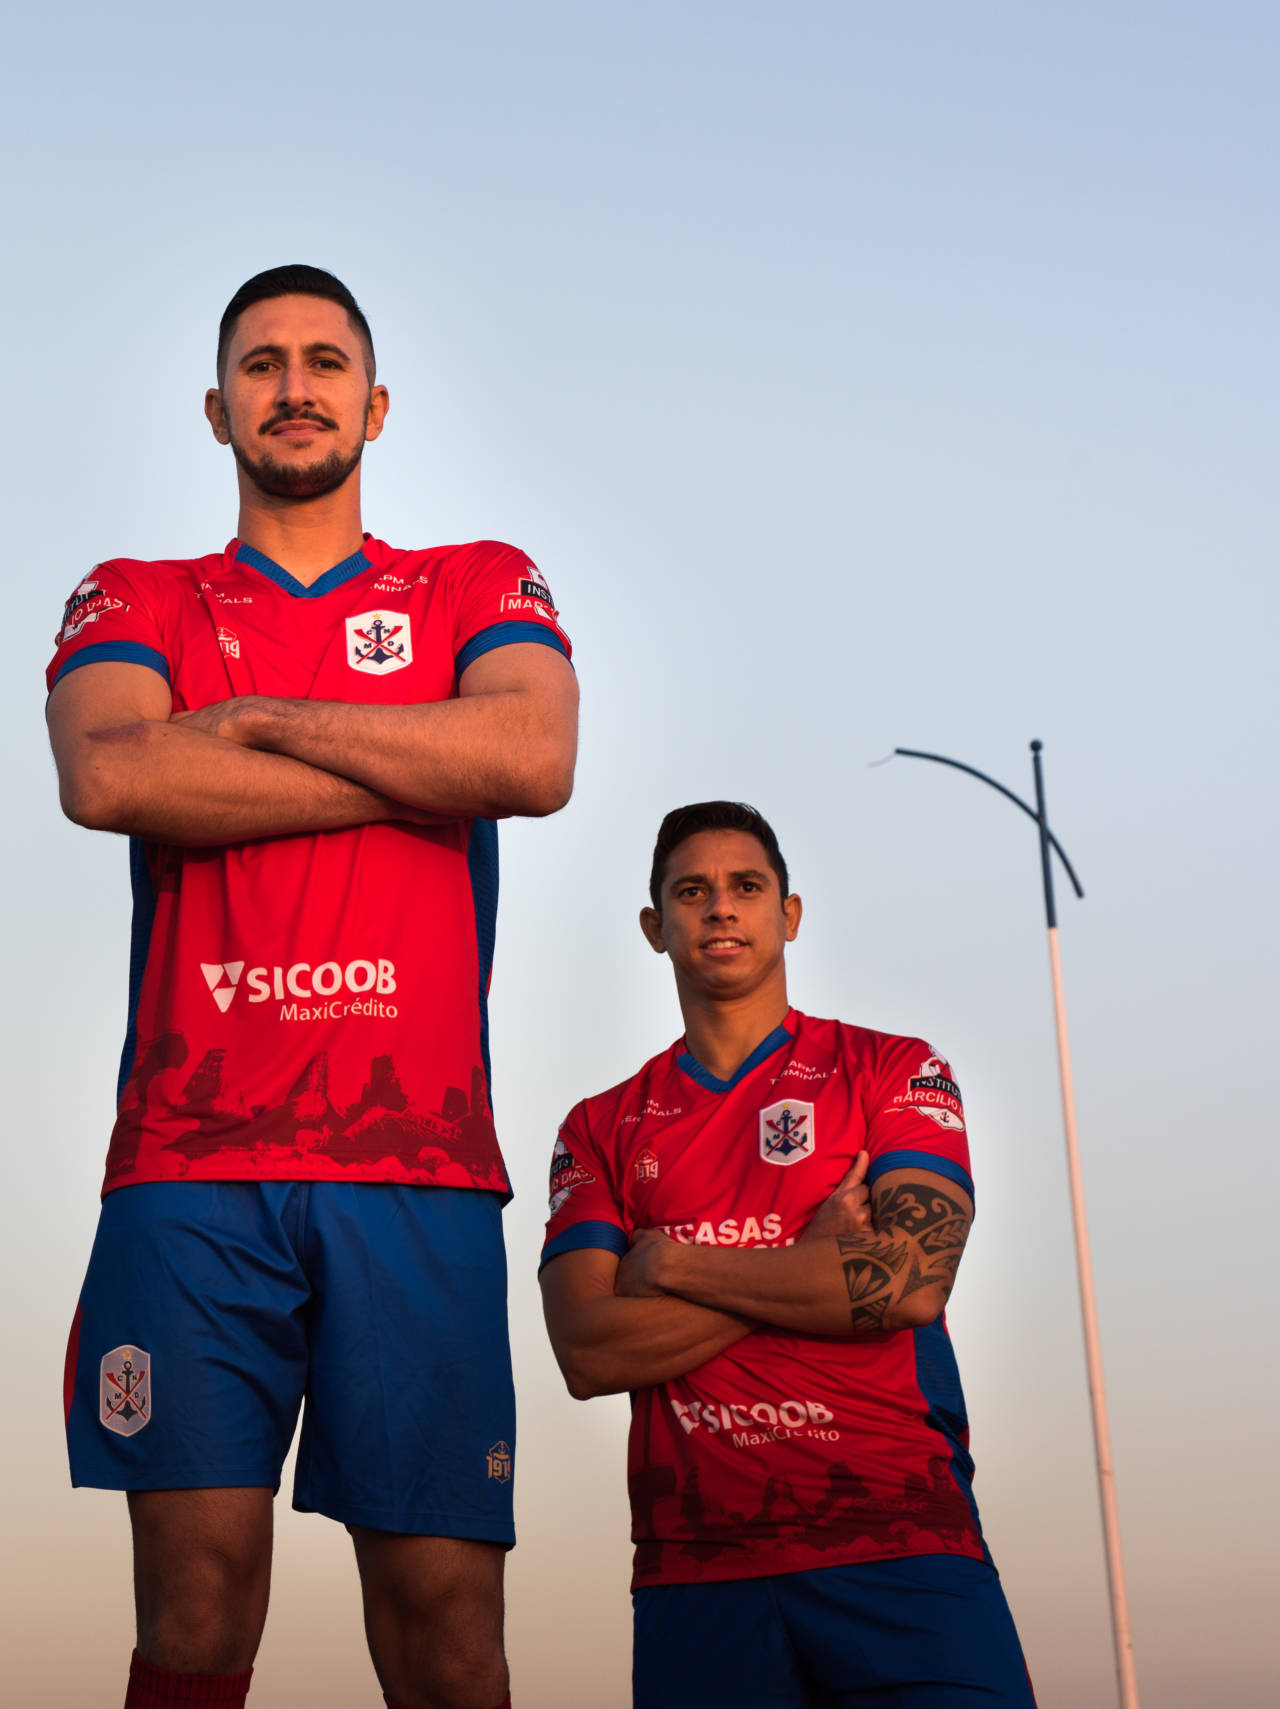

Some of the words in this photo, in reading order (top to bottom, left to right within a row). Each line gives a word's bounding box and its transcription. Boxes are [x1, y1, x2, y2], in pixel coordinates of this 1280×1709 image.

[246, 958, 397, 1003] SICOOB
[279, 997, 399, 1022] MaxiCrédito
[732, 1425, 840, 1449] MaxiCrito
